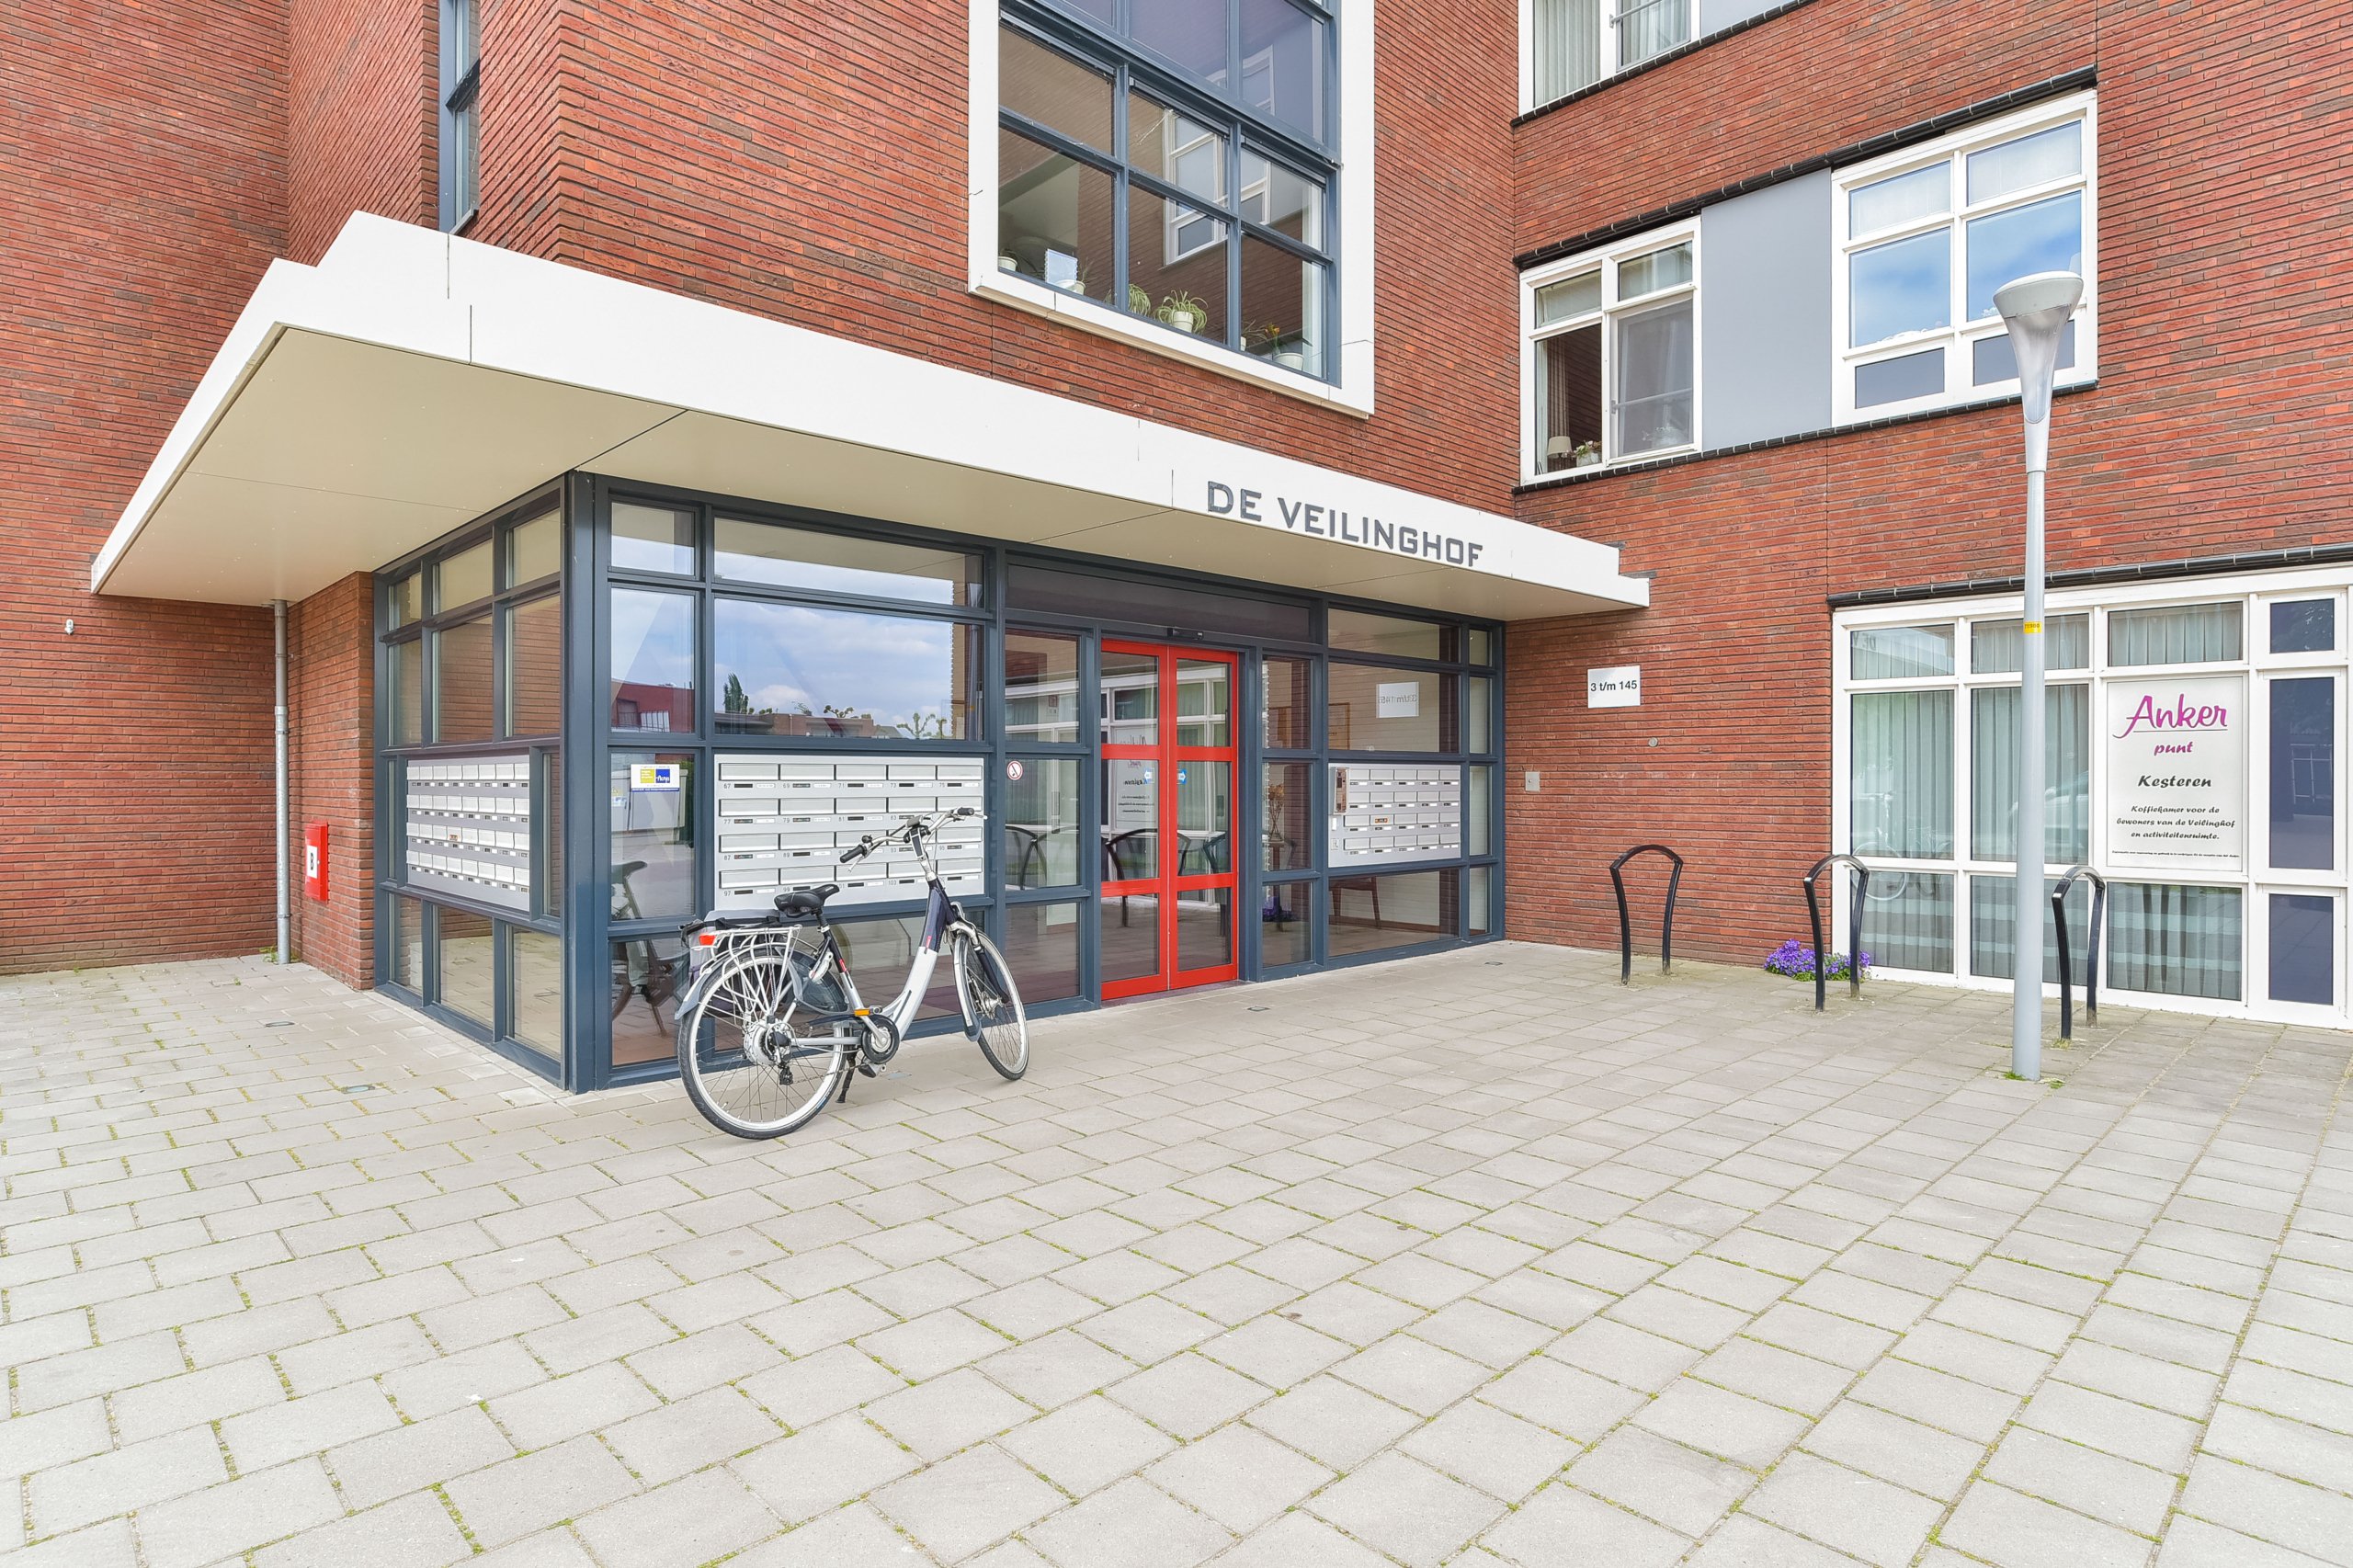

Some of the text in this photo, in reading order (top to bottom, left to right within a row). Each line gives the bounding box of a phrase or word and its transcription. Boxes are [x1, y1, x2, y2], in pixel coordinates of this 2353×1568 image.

[1207, 481, 1483, 568] DE VEILINGHOF
[1590, 680, 1637, 691] 3 t/m 145
[2112, 694, 2228, 738] Anker
[2154, 741, 2193, 756] punt
[2138, 775, 2211, 788] Kesteren
[2131, 805, 2184, 813] Koffiekamer
[2188, 819, 2235, 828] Veilinghof
